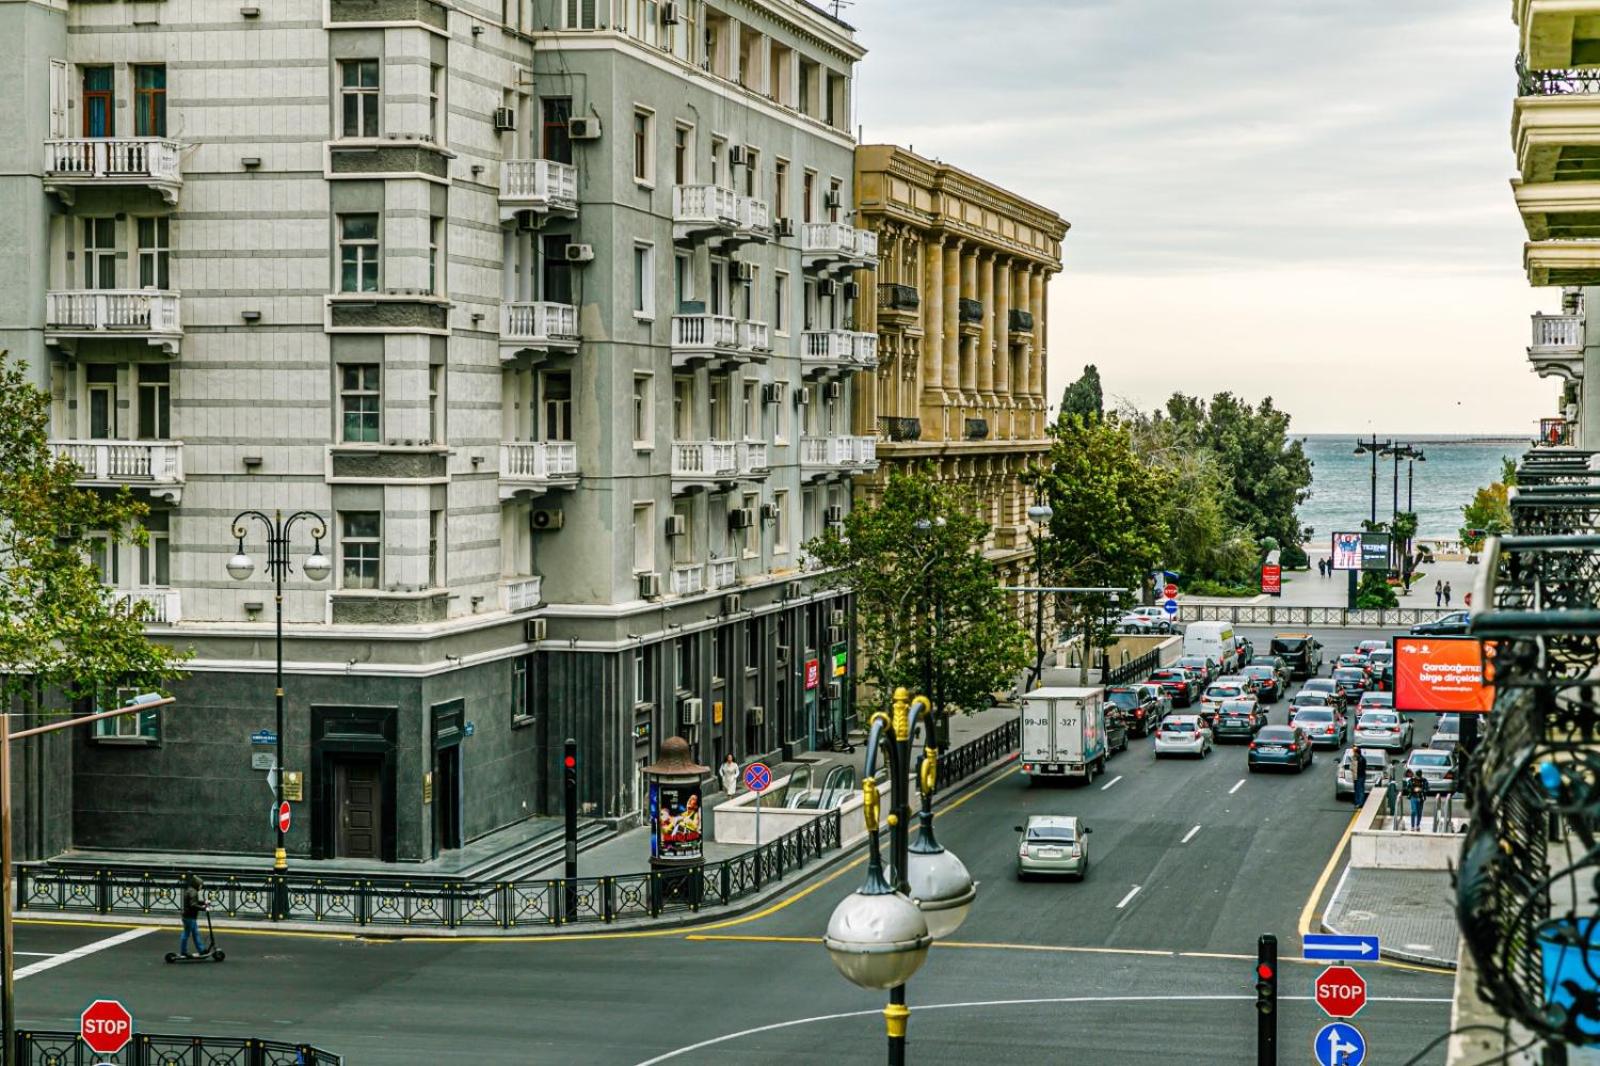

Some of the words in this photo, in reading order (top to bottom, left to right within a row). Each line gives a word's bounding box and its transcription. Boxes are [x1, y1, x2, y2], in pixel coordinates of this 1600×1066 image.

[1025, 718, 1048, 726] 99-JB
[1060, 718, 1077, 726] -327
[1319, 984, 1362, 1000] STOP
[85, 1018, 128, 1035] STOP
